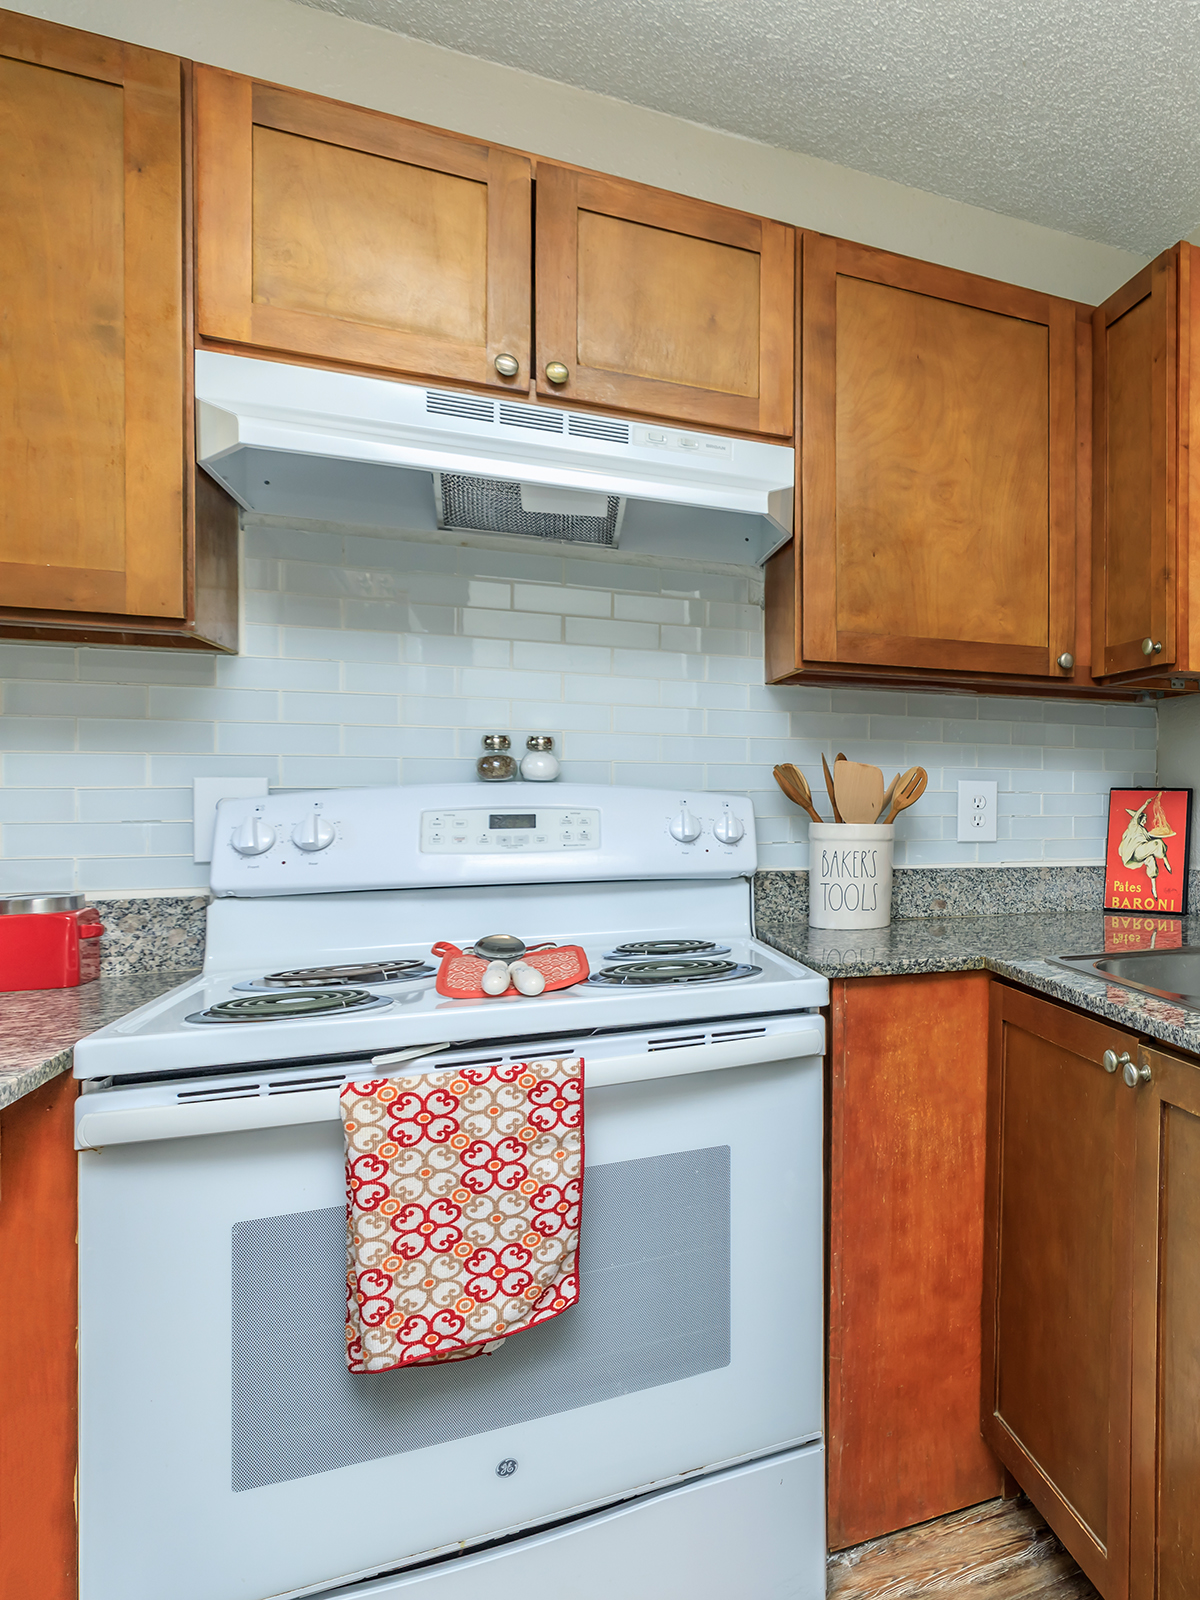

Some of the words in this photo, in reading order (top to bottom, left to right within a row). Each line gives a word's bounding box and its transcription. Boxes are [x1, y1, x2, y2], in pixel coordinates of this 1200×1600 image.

[821, 849, 878, 878] BAKER'S
[820, 882, 878, 911] TOOLS
[1112, 896, 1175, 911] BARONI
